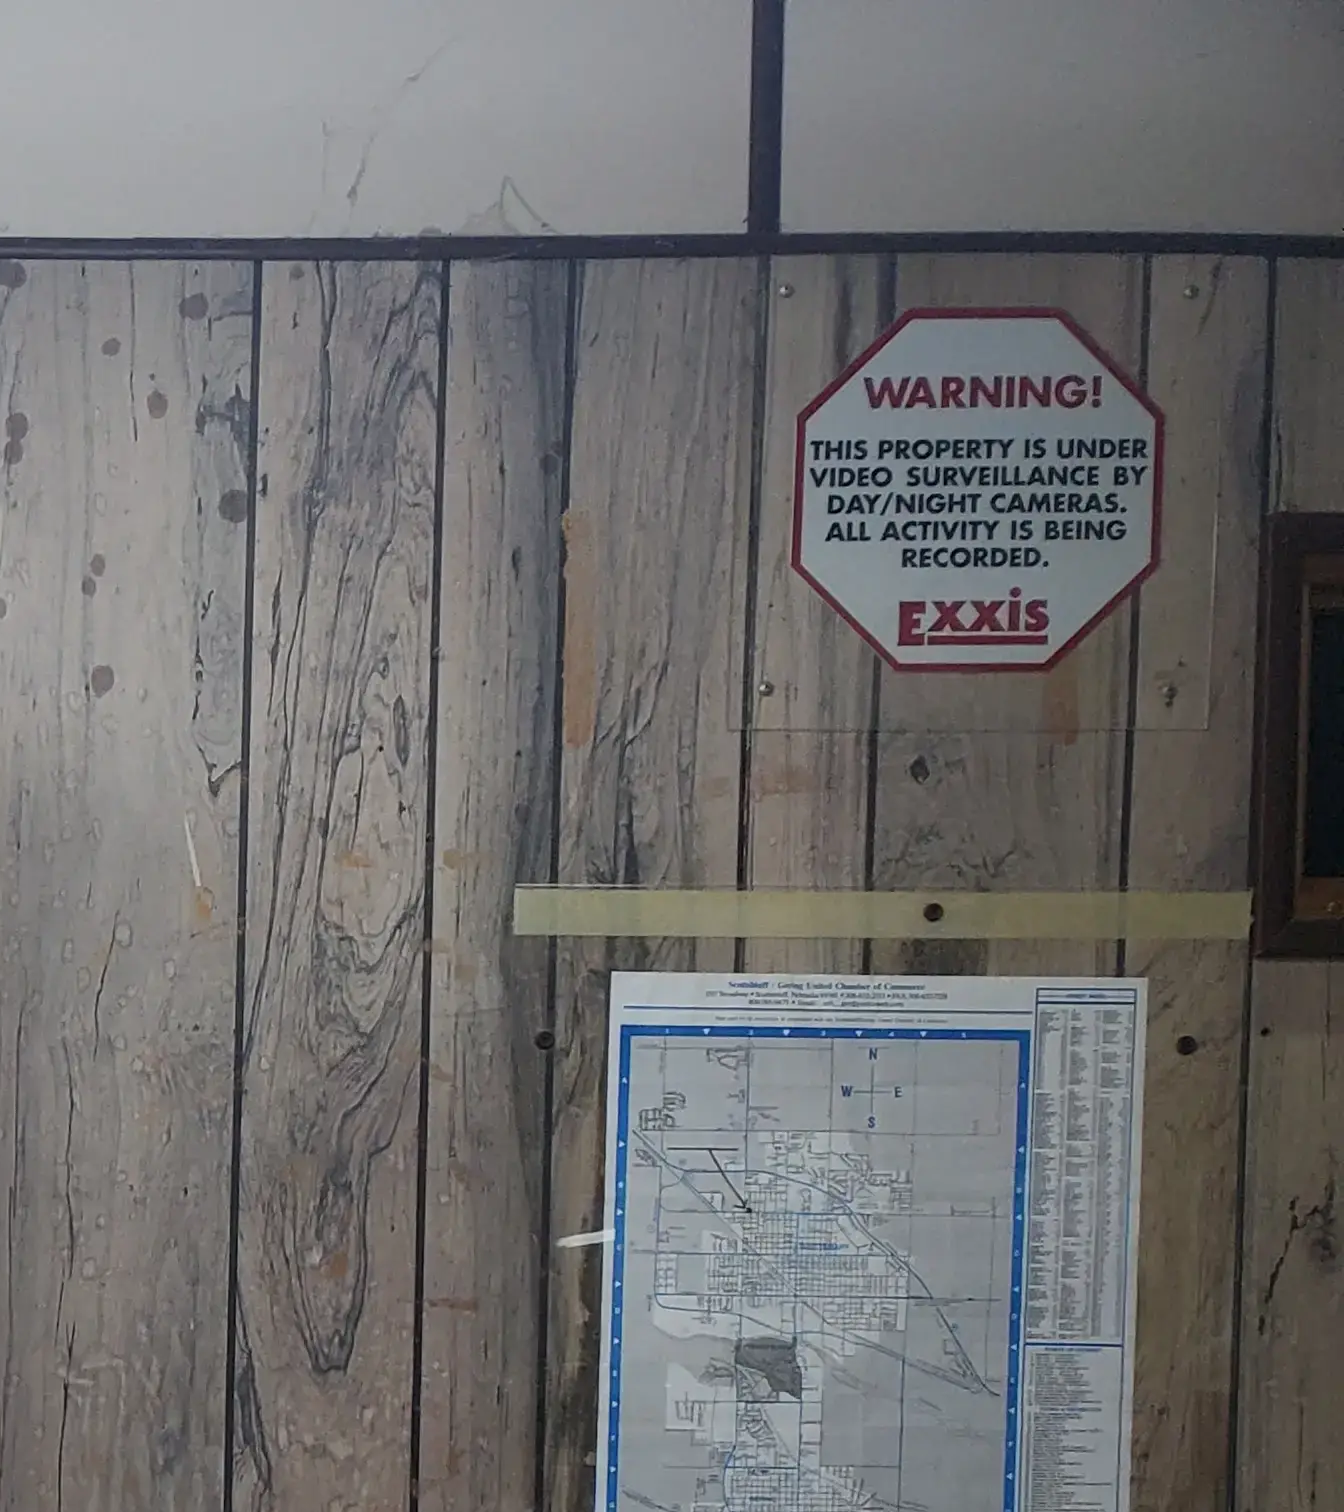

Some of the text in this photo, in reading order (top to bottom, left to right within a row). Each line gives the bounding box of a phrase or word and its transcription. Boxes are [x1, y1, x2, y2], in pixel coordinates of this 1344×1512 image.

[864, 375, 1102, 409] WARNING!
[811, 438, 1148, 460] THIS PROPERTY IS UNDER
[810, 465, 1148, 488] VIDEO SURVEILLANCE BY
[827, 493, 1127, 516] DAY/NIGHT CAMERAS.
[825, 520, 1127, 542] ALL ACTIVITY IS BEING
[901, 547, 1049, 568] RECORDED.
[869, 1047, 878, 1060] N
[841, 1086, 853, 1097] W
[894, 1086, 903, 1098] E
[868, 1116, 876, 1128] S
